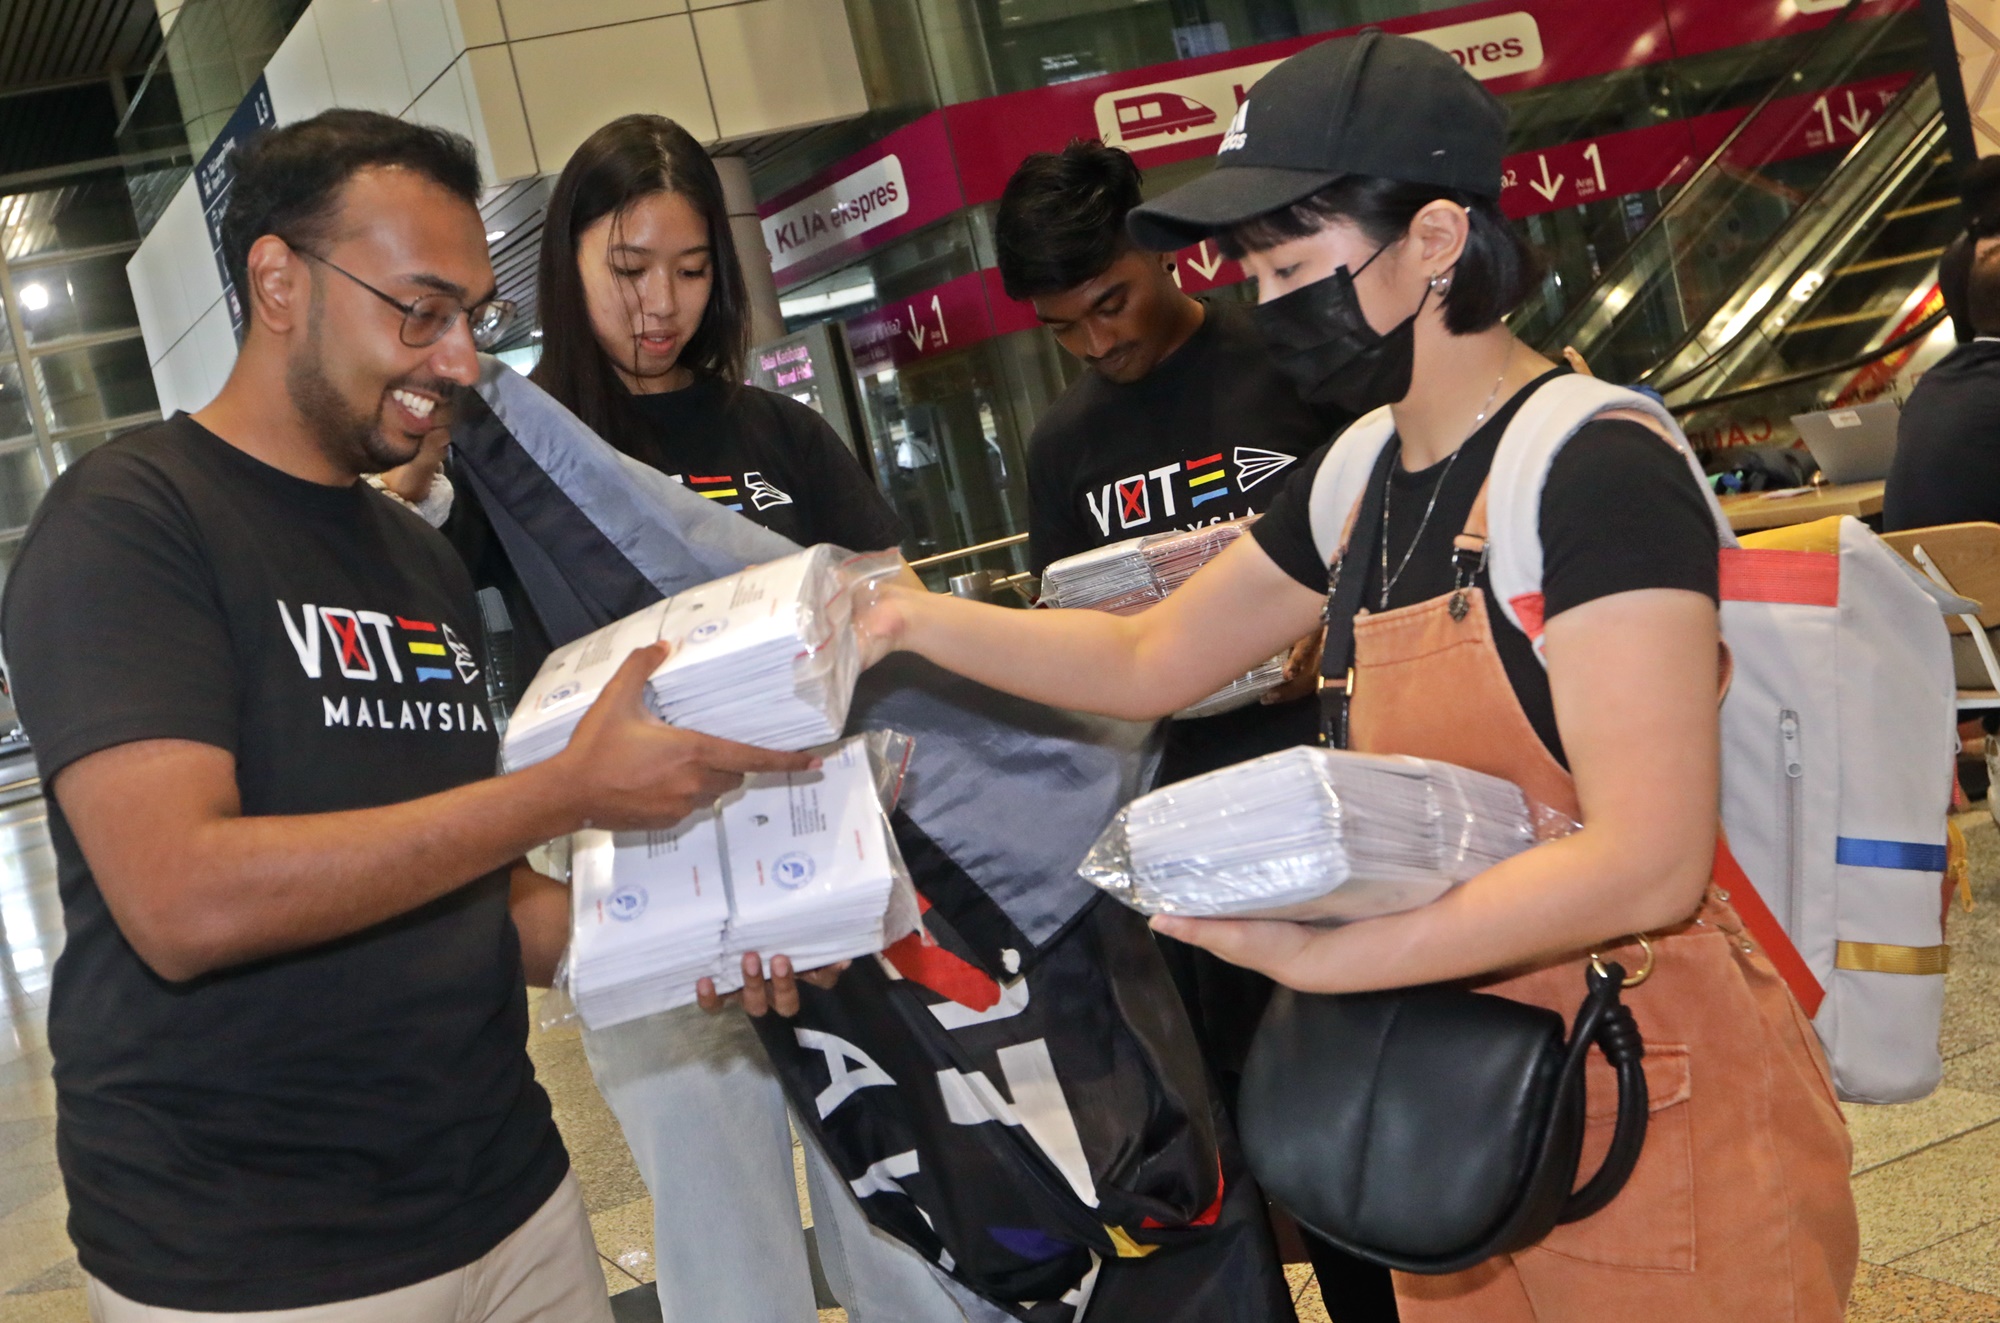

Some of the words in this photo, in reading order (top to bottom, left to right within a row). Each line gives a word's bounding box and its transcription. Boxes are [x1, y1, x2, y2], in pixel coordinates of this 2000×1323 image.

[774, 210, 829, 254] KLIA
[830, 181, 899, 229] ekspres
[1085, 452, 1229, 537] VOTE
[277, 599, 454, 684] VOTE
[321, 695, 488, 732] MALAYSIA
